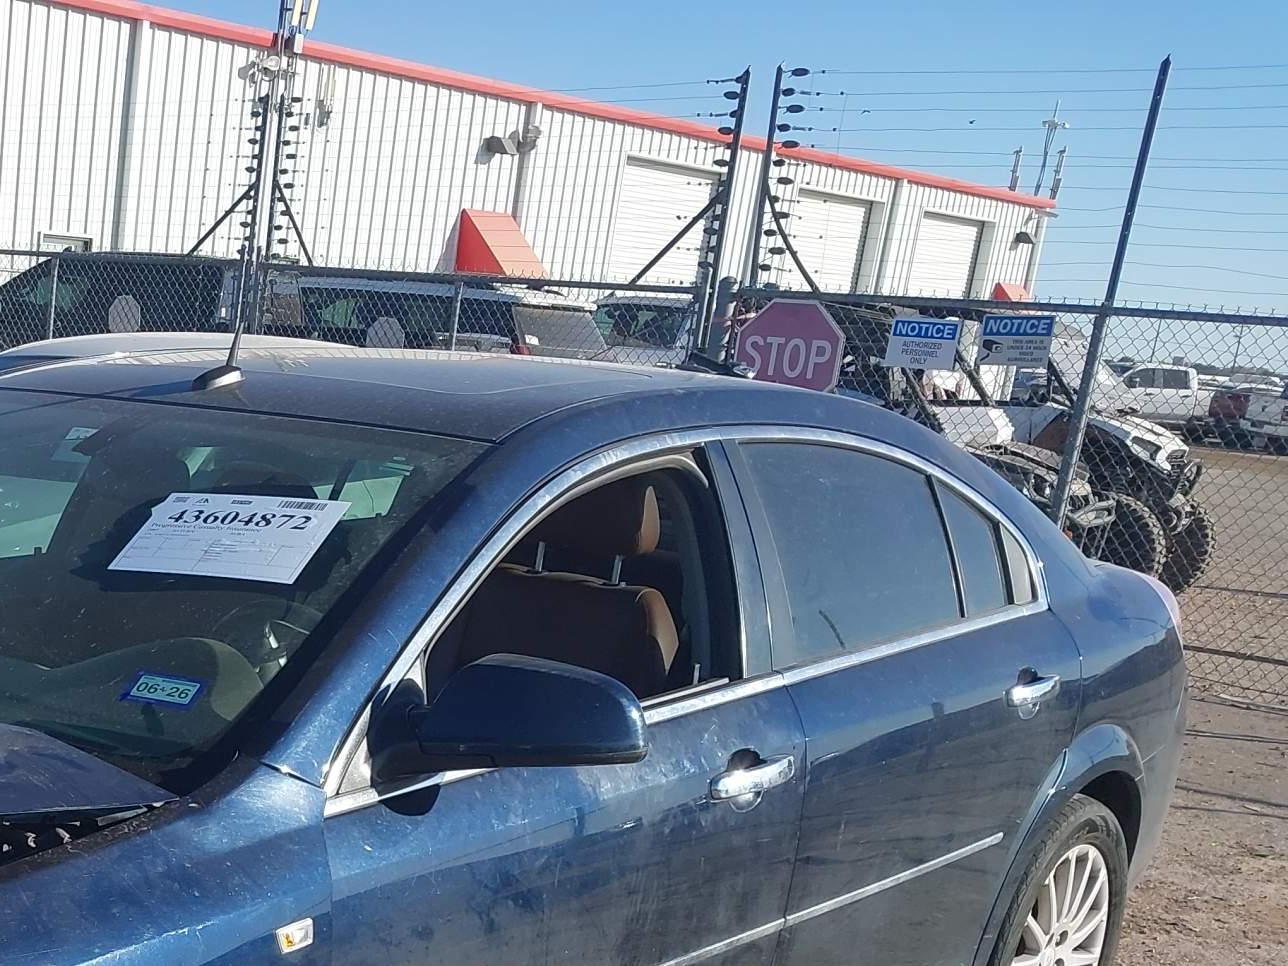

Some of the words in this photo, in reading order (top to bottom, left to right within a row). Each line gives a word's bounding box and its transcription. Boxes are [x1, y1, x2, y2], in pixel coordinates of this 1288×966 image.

[895, 322, 955, 338] NOTICE
[985, 319, 1051, 334] NOTICE
[901, 348, 938, 358] PERSONNEL
[902, 341, 943, 350] AUTHORIZED
[744, 335, 832, 380] STOP
[909, 356, 928, 364] ONLY
[167, 509, 313, 531] 43604872
